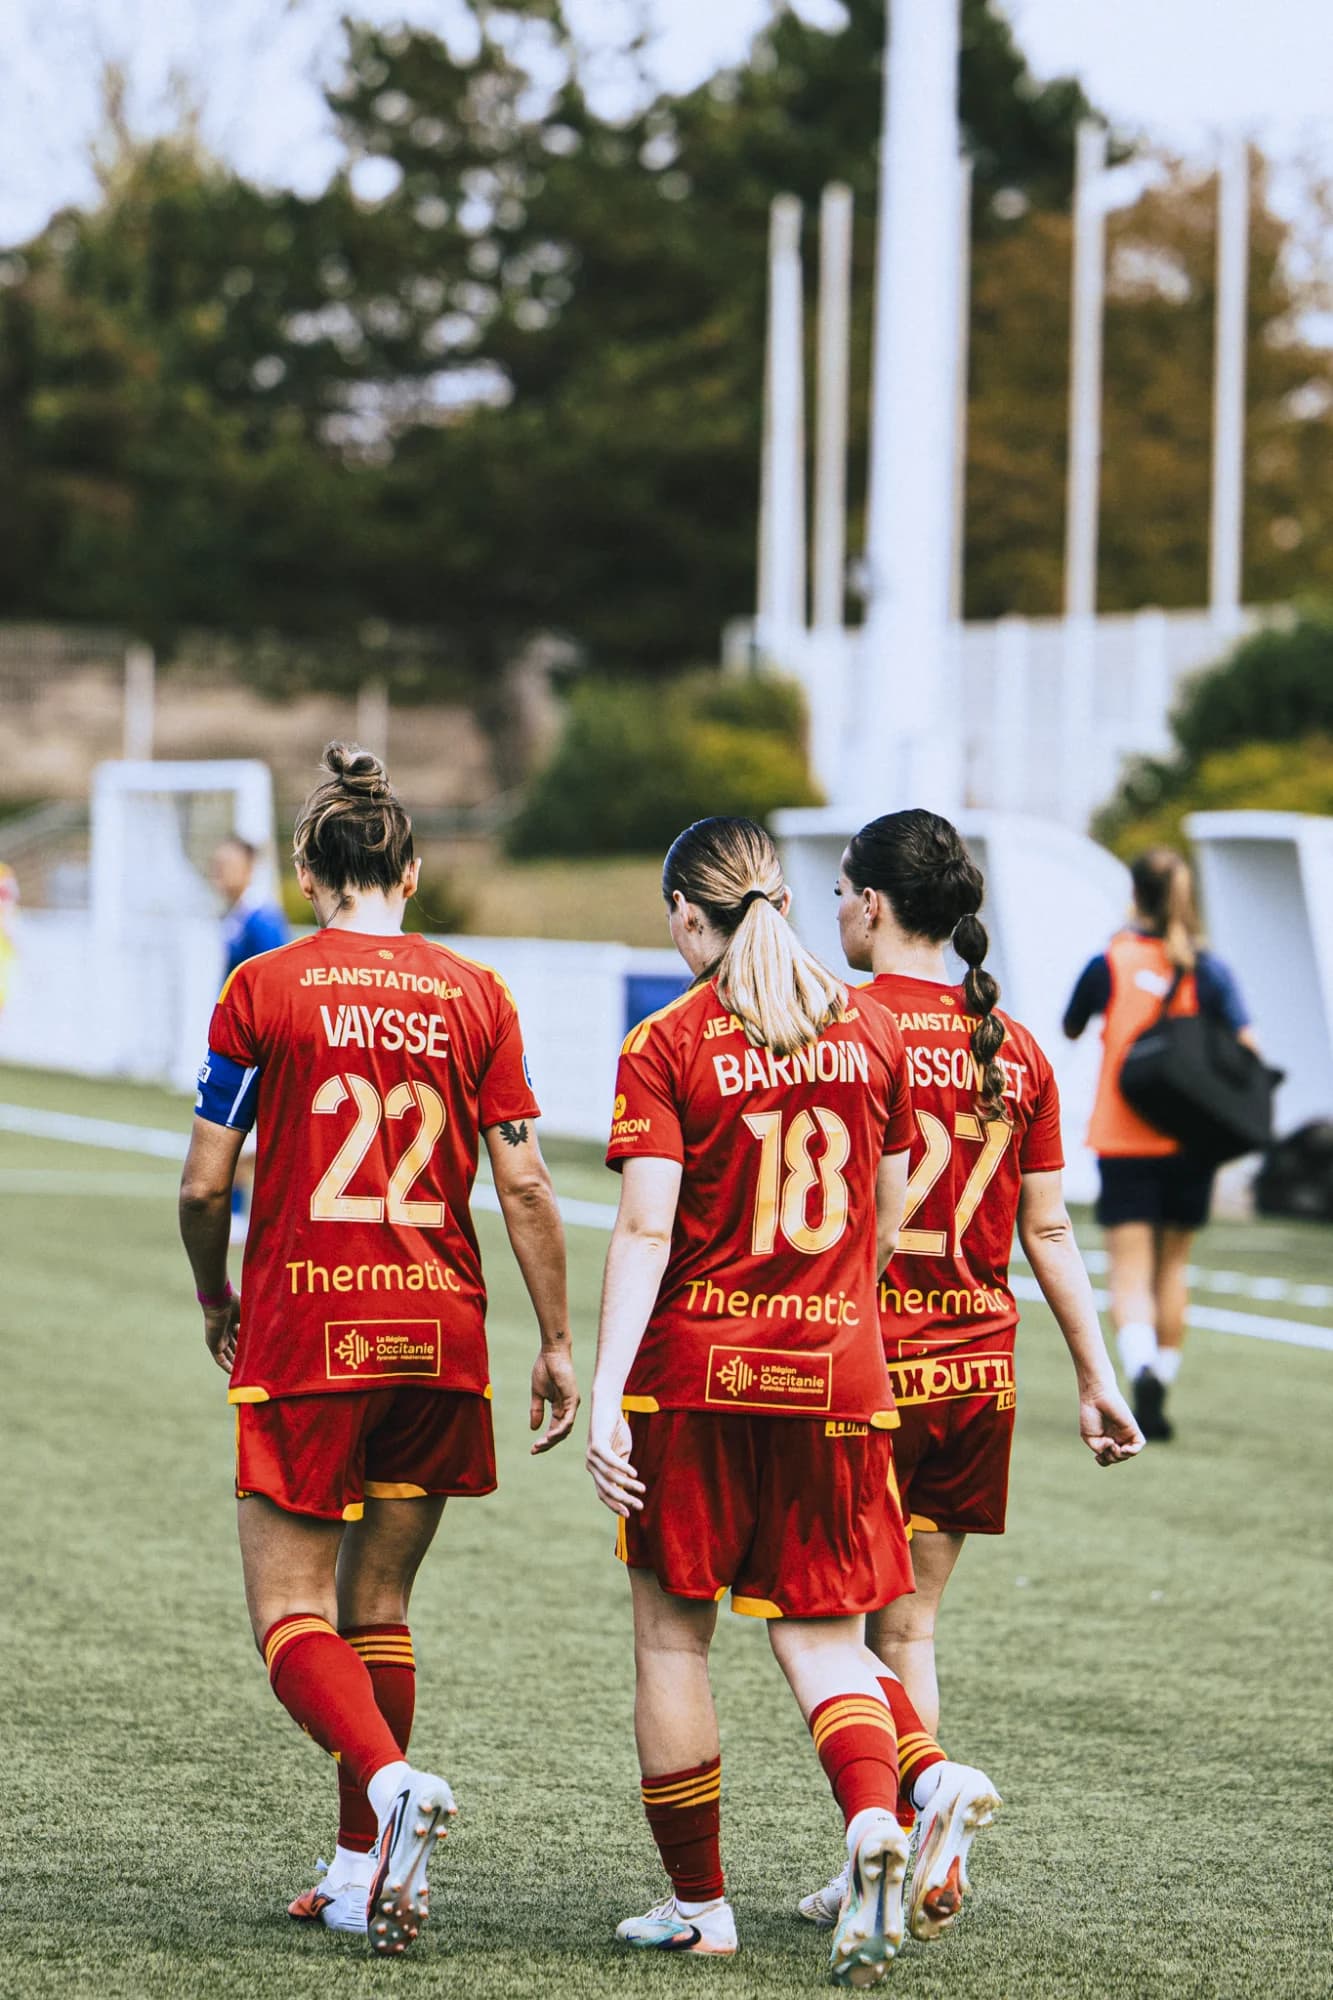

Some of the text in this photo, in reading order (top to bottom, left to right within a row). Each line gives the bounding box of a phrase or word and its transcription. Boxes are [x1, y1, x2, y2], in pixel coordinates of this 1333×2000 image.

[319, 1004, 449, 1058] VAYSSE
[712, 1039, 869, 1097] BARNOIN
[311, 1073, 446, 1228] 22
[742, 1106, 851, 1255] 18
[895, 1109, 1014, 1258] 27
[286, 1259, 461, 1294] Thermatic
[684, 1280, 861, 1326] Thermatic
[376, 1342, 434, 1355] Occitanie
[760, 1373, 825, 1388] Occitanie
